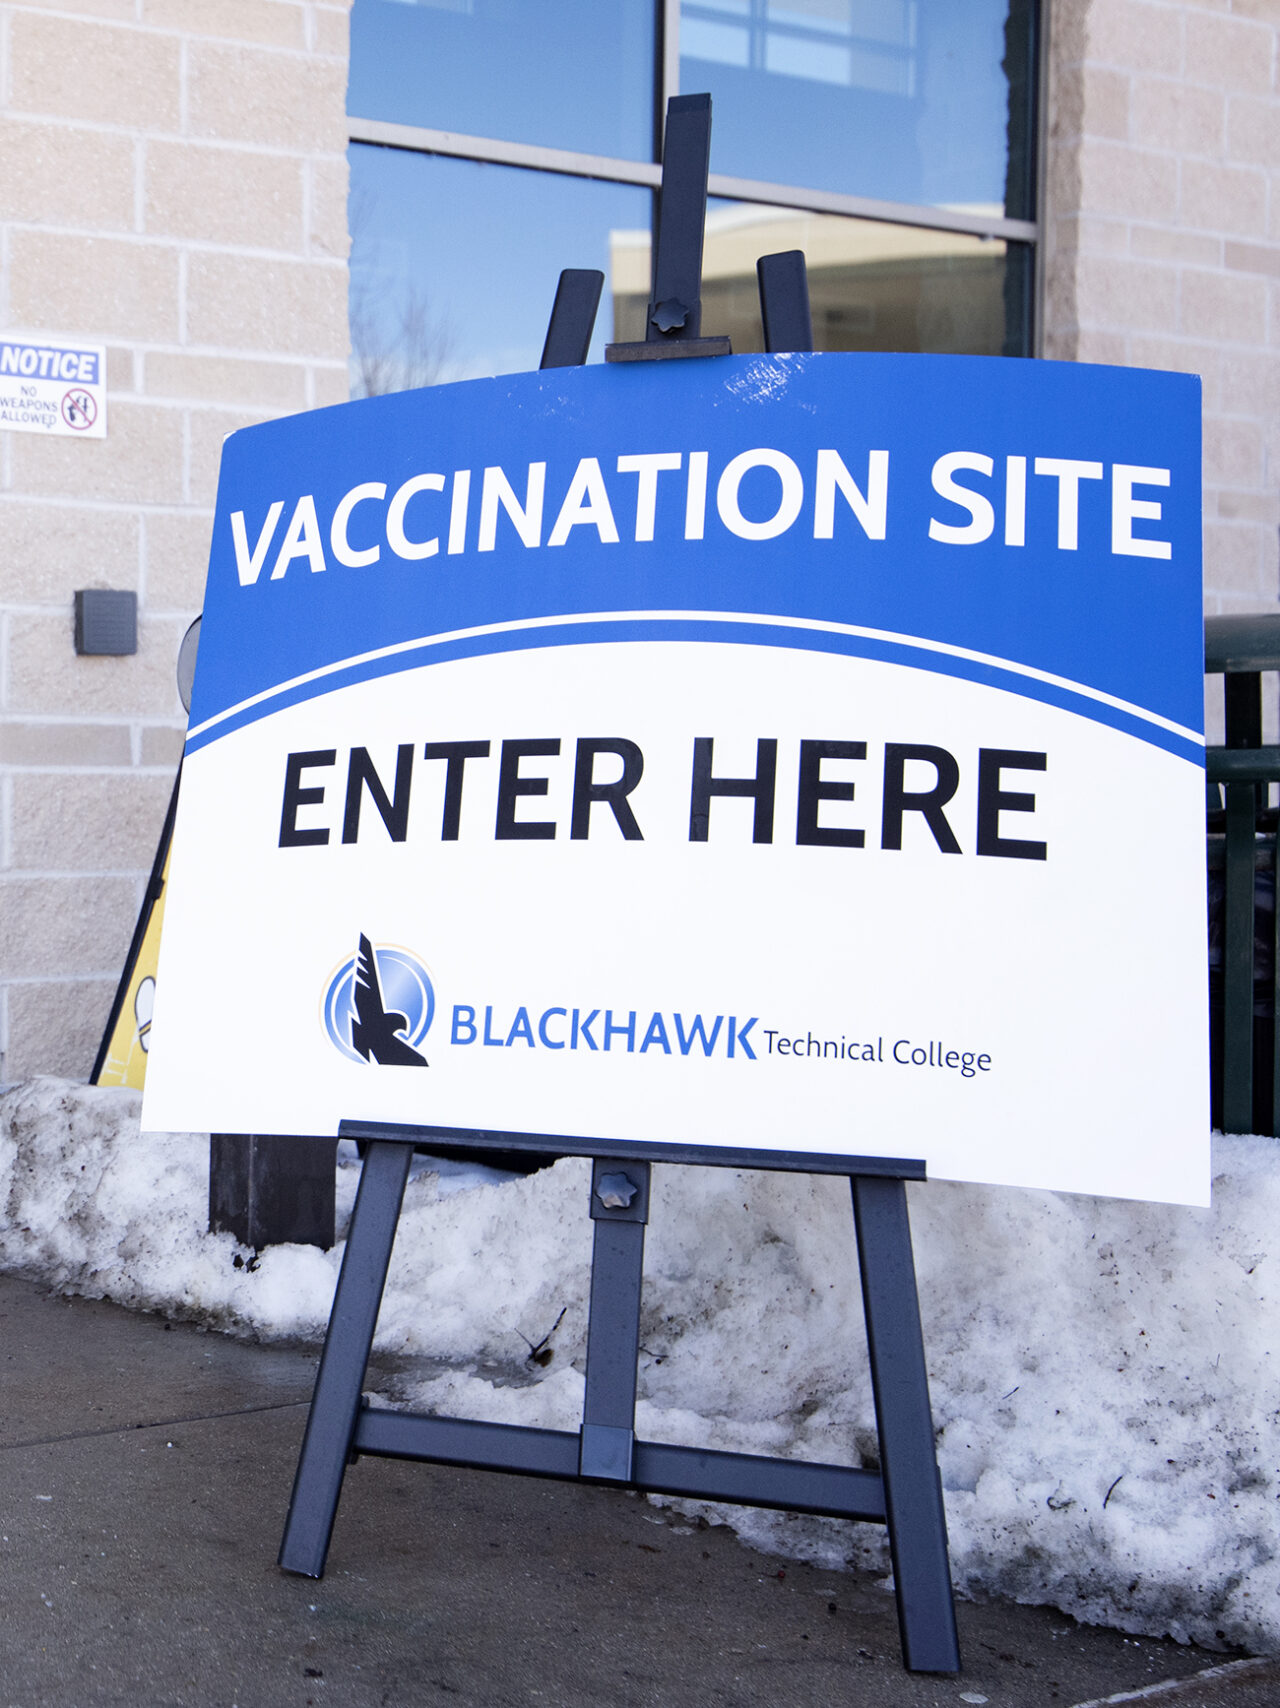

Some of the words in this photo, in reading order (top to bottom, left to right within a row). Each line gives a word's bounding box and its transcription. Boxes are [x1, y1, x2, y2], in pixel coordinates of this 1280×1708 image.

[0, 345, 96, 381] NOTICE
[0, 397, 58, 412] WEAPONS
[20, 385, 37, 397] NO
[1, 410, 57, 425] ALLOWED
[230, 447, 890, 587] VACCINATION
[928, 450, 1172, 560] SITE
[278, 737, 645, 849] ENTER
[688, 737, 1048, 861] HERE
[450, 1004, 759, 1060] BLACKHAWK
[763, 1030, 884, 1063] Technical
[892, 1039, 992, 1078] College
